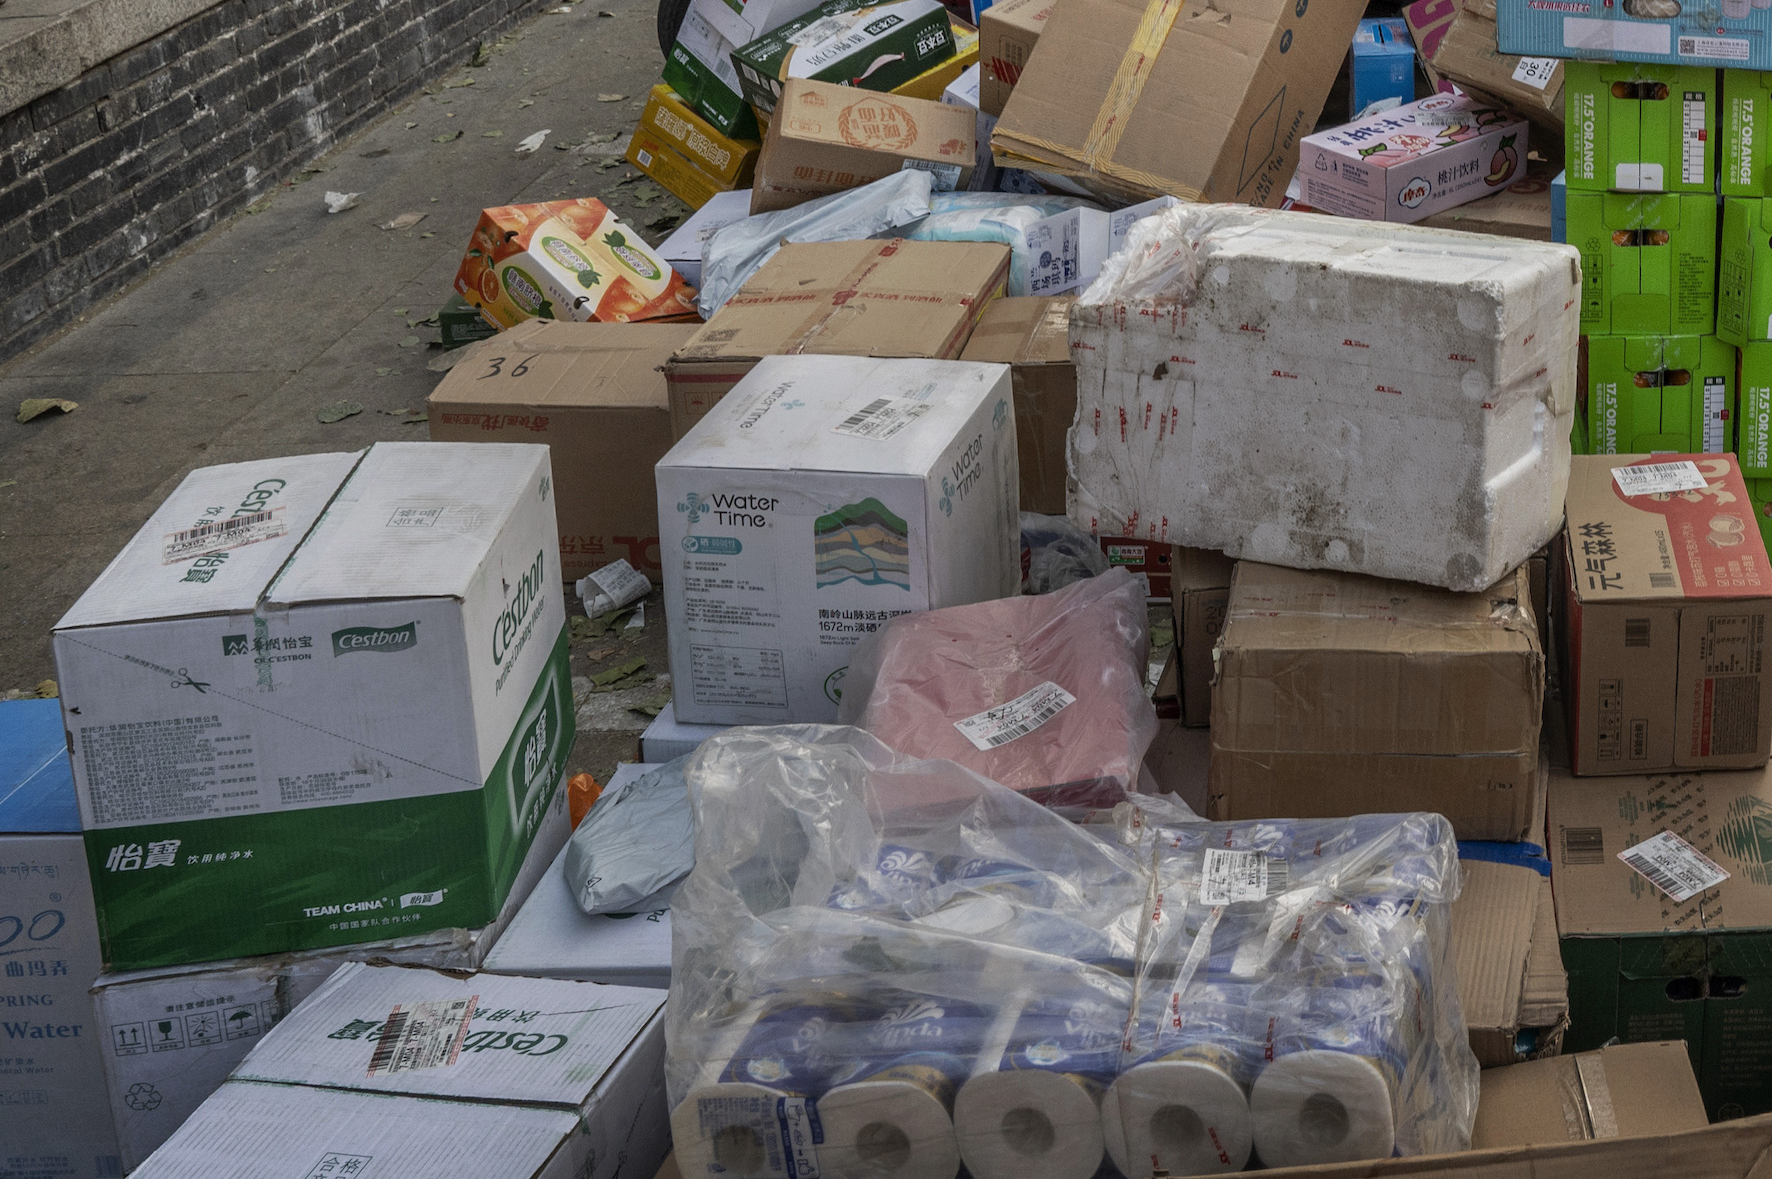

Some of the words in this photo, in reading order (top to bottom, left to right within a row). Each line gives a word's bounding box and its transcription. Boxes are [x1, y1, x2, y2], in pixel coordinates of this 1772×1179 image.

[507, 267, 544, 309] 赣南脐橙
[477, 353, 540, 380] 36
[951, 433, 983, 481] Water
[956, 462, 982, 502] Time
[712, 494, 779, 511] Water
[713, 511, 766, 527] Time
[1578, 521, 1623, 591] 元气森林
[818, 621, 882, 633] 1672m淡硒
[339, 629, 411, 649] C'estbon
[106, 838, 182, 873] 怡寶
[186, 847, 255, 866] 饮用纯净水
[303, 900, 341, 919] TEAM
[342, 897, 384, 915] CHINA
[328, 911, 423, 933] 中国国家队合作伙伴
[4, 1021, 84, 1041] Water
